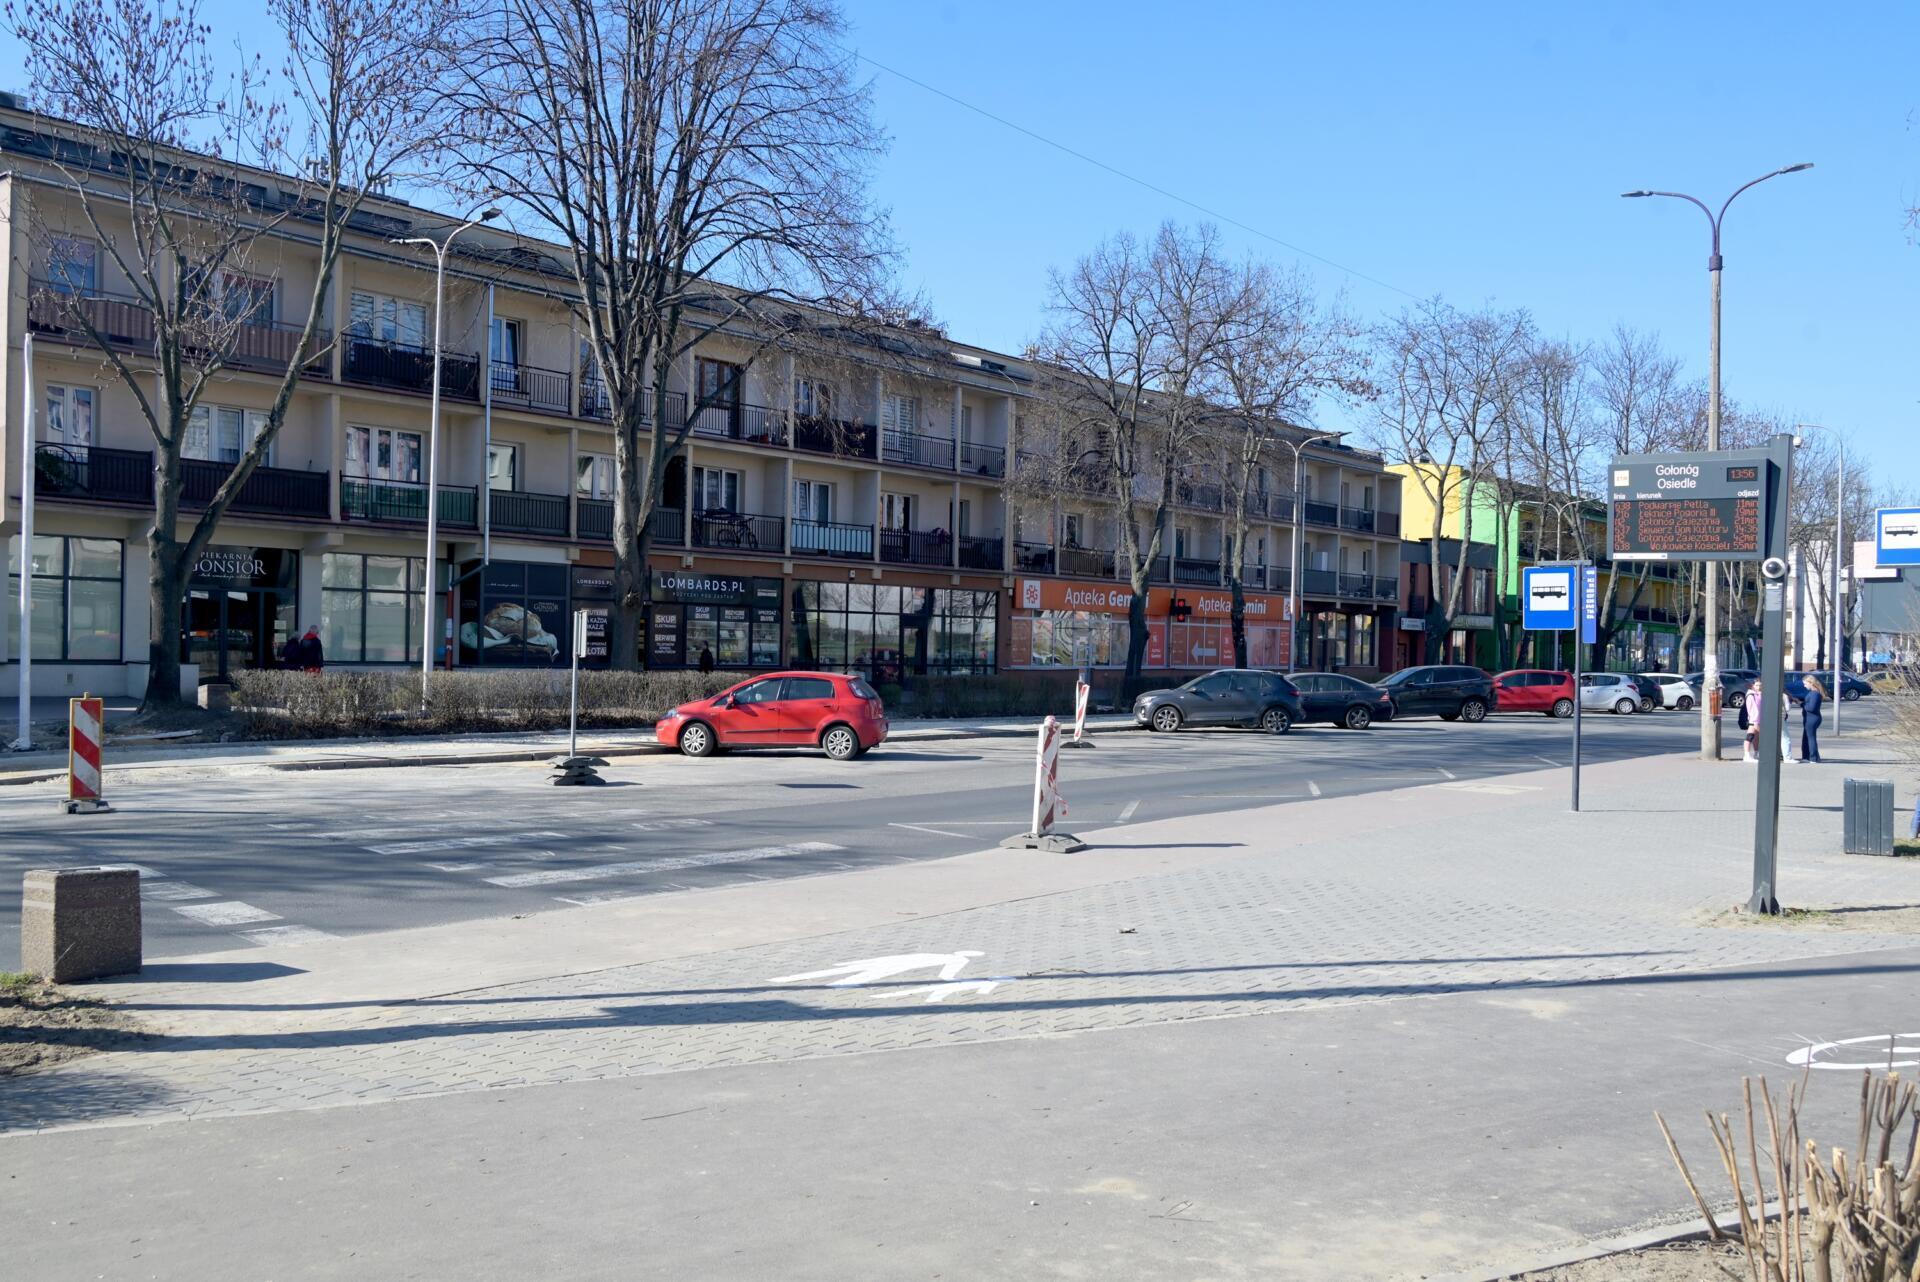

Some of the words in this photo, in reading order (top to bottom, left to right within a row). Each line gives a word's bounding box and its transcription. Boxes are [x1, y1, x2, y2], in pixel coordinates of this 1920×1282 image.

[1655, 464, 1699, 476] Gołonóg
[1657, 478, 1697, 489] Osiedle
[1737, 489, 1760, 498] odjazd
[200, 551, 253, 561] PIEKARNIA
[660, 577, 745, 593] LOMBARDS.PL
[1064, 586, 1106, 610] Apteka
[1108, 590, 1150, 608] Gemi
[1198, 595, 1232, 615] Apteka
